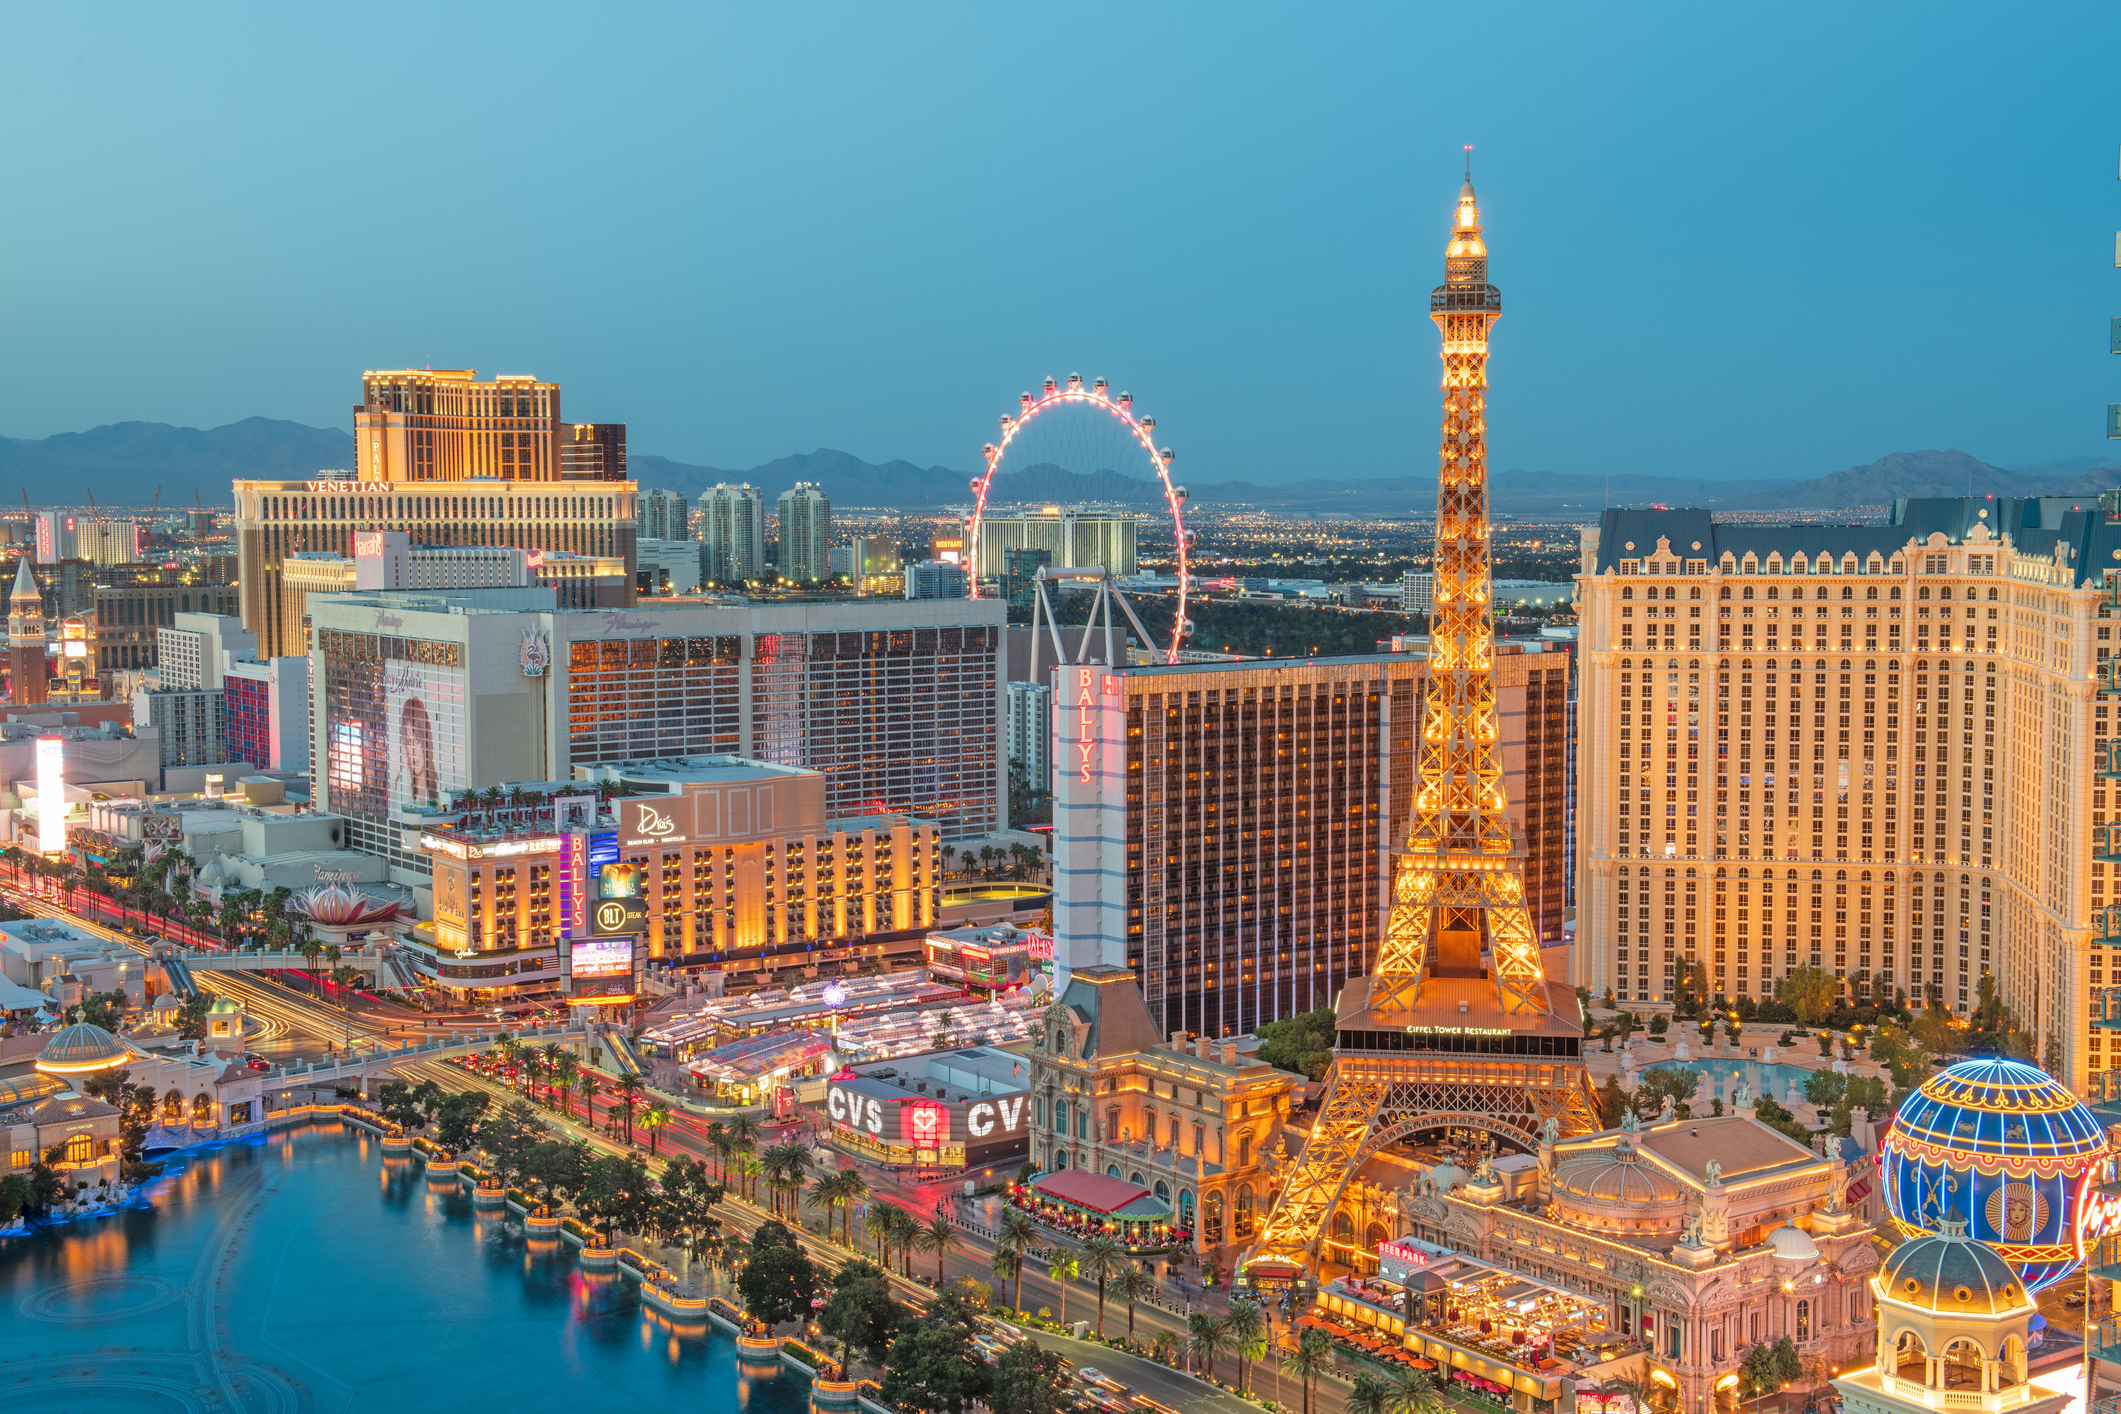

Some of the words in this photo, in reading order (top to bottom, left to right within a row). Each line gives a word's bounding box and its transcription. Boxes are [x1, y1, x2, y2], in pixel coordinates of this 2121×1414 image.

[306, 481, 390, 492] VENETIAN
[936, 540, 963, 548] WESTGATE
[602, 612, 660, 634] Flamingo
[1077, 668, 1095, 783] BALLYS
[637, 803, 675, 835] Drai's
[314, 864, 363, 882] Flamingo
[571, 837, 585, 926] BALLYS
[604, 909, 620, 924] BLT
[829, 1086, 882, 1133] CVS
[968, 1097, 1031, 1136] CV
[1379, 1241, 1400, 1257] BEER
[1402, 1249, 1425, 1266] PARK
